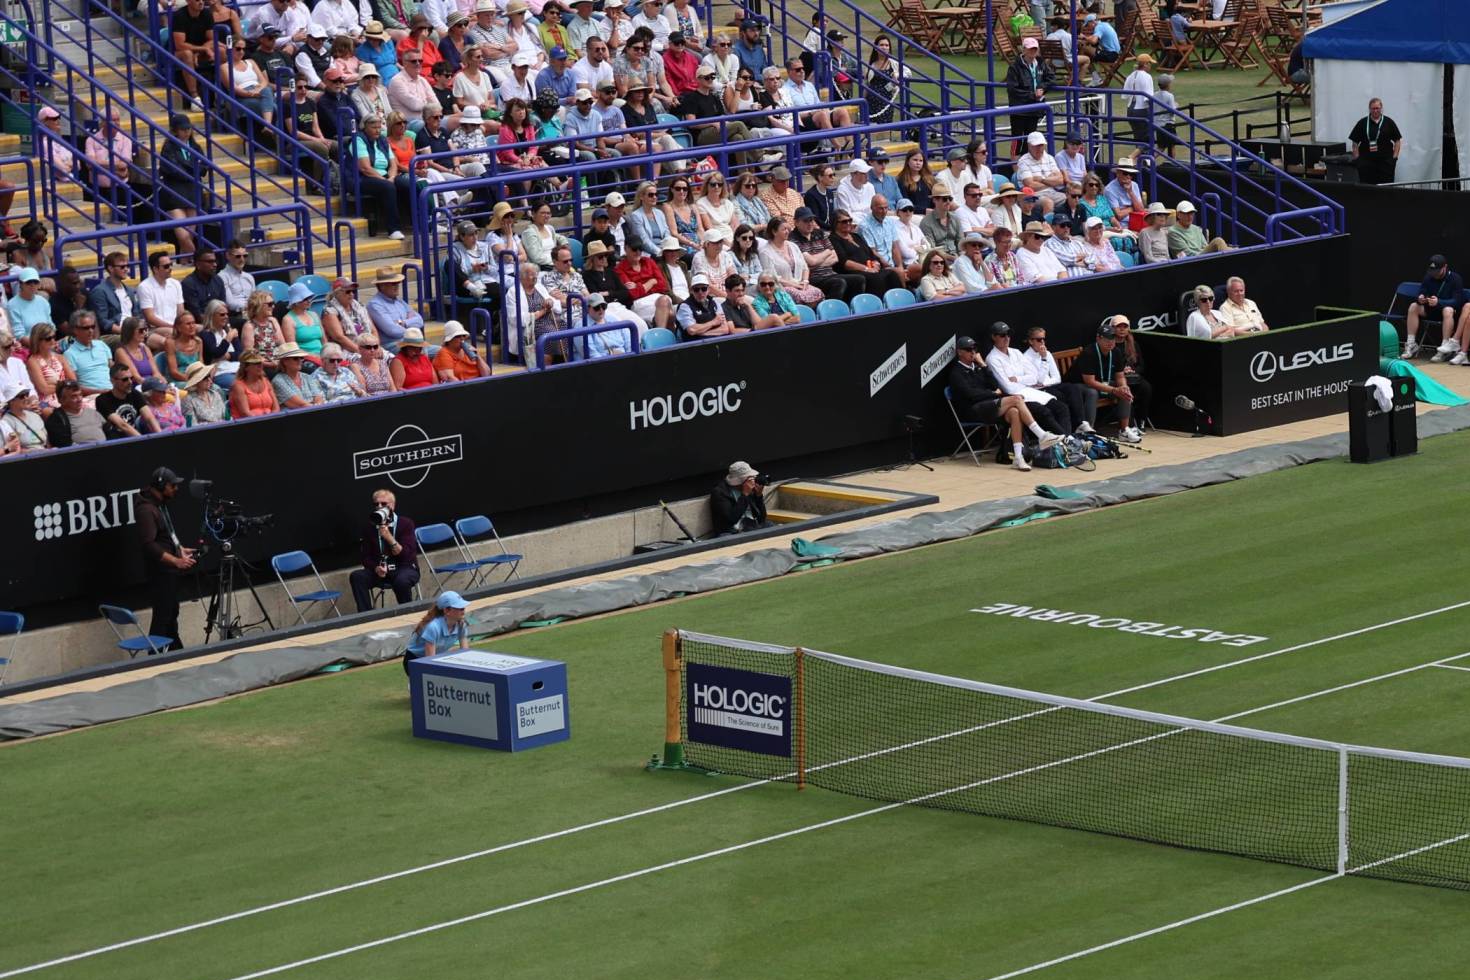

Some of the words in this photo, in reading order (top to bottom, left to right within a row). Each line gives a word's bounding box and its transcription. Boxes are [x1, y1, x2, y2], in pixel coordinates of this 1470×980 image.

[1137, 311, 1179, 332] EXU
[872, 352, 905, 389] Schweppes
[923, 344, 955, 380] Schweppes
[1279, 342, 1354, 371] LEXUS
[629, 382, 742, 430] HOLOGIC
[1251, 395, 1272, 409] BEST
[1273, 391, 1293, 406] SEAT
[1294, 389, 1304, 401] IN
[1305, 385, 1322, 399] THE
[360, 443, 457, 470] SOUTHERN
[66, 488, 141, 535] BRIT
[969, 602, 1269, 647] EASTBOURNE
[426, 681, 491, 706] Butternut
[694, 682, 783, 718] HOLOGIC
[428, 699, 452, 717] Box
[519, 701, 561, 717] Butternut
[520, 717, 536, 728] Box
